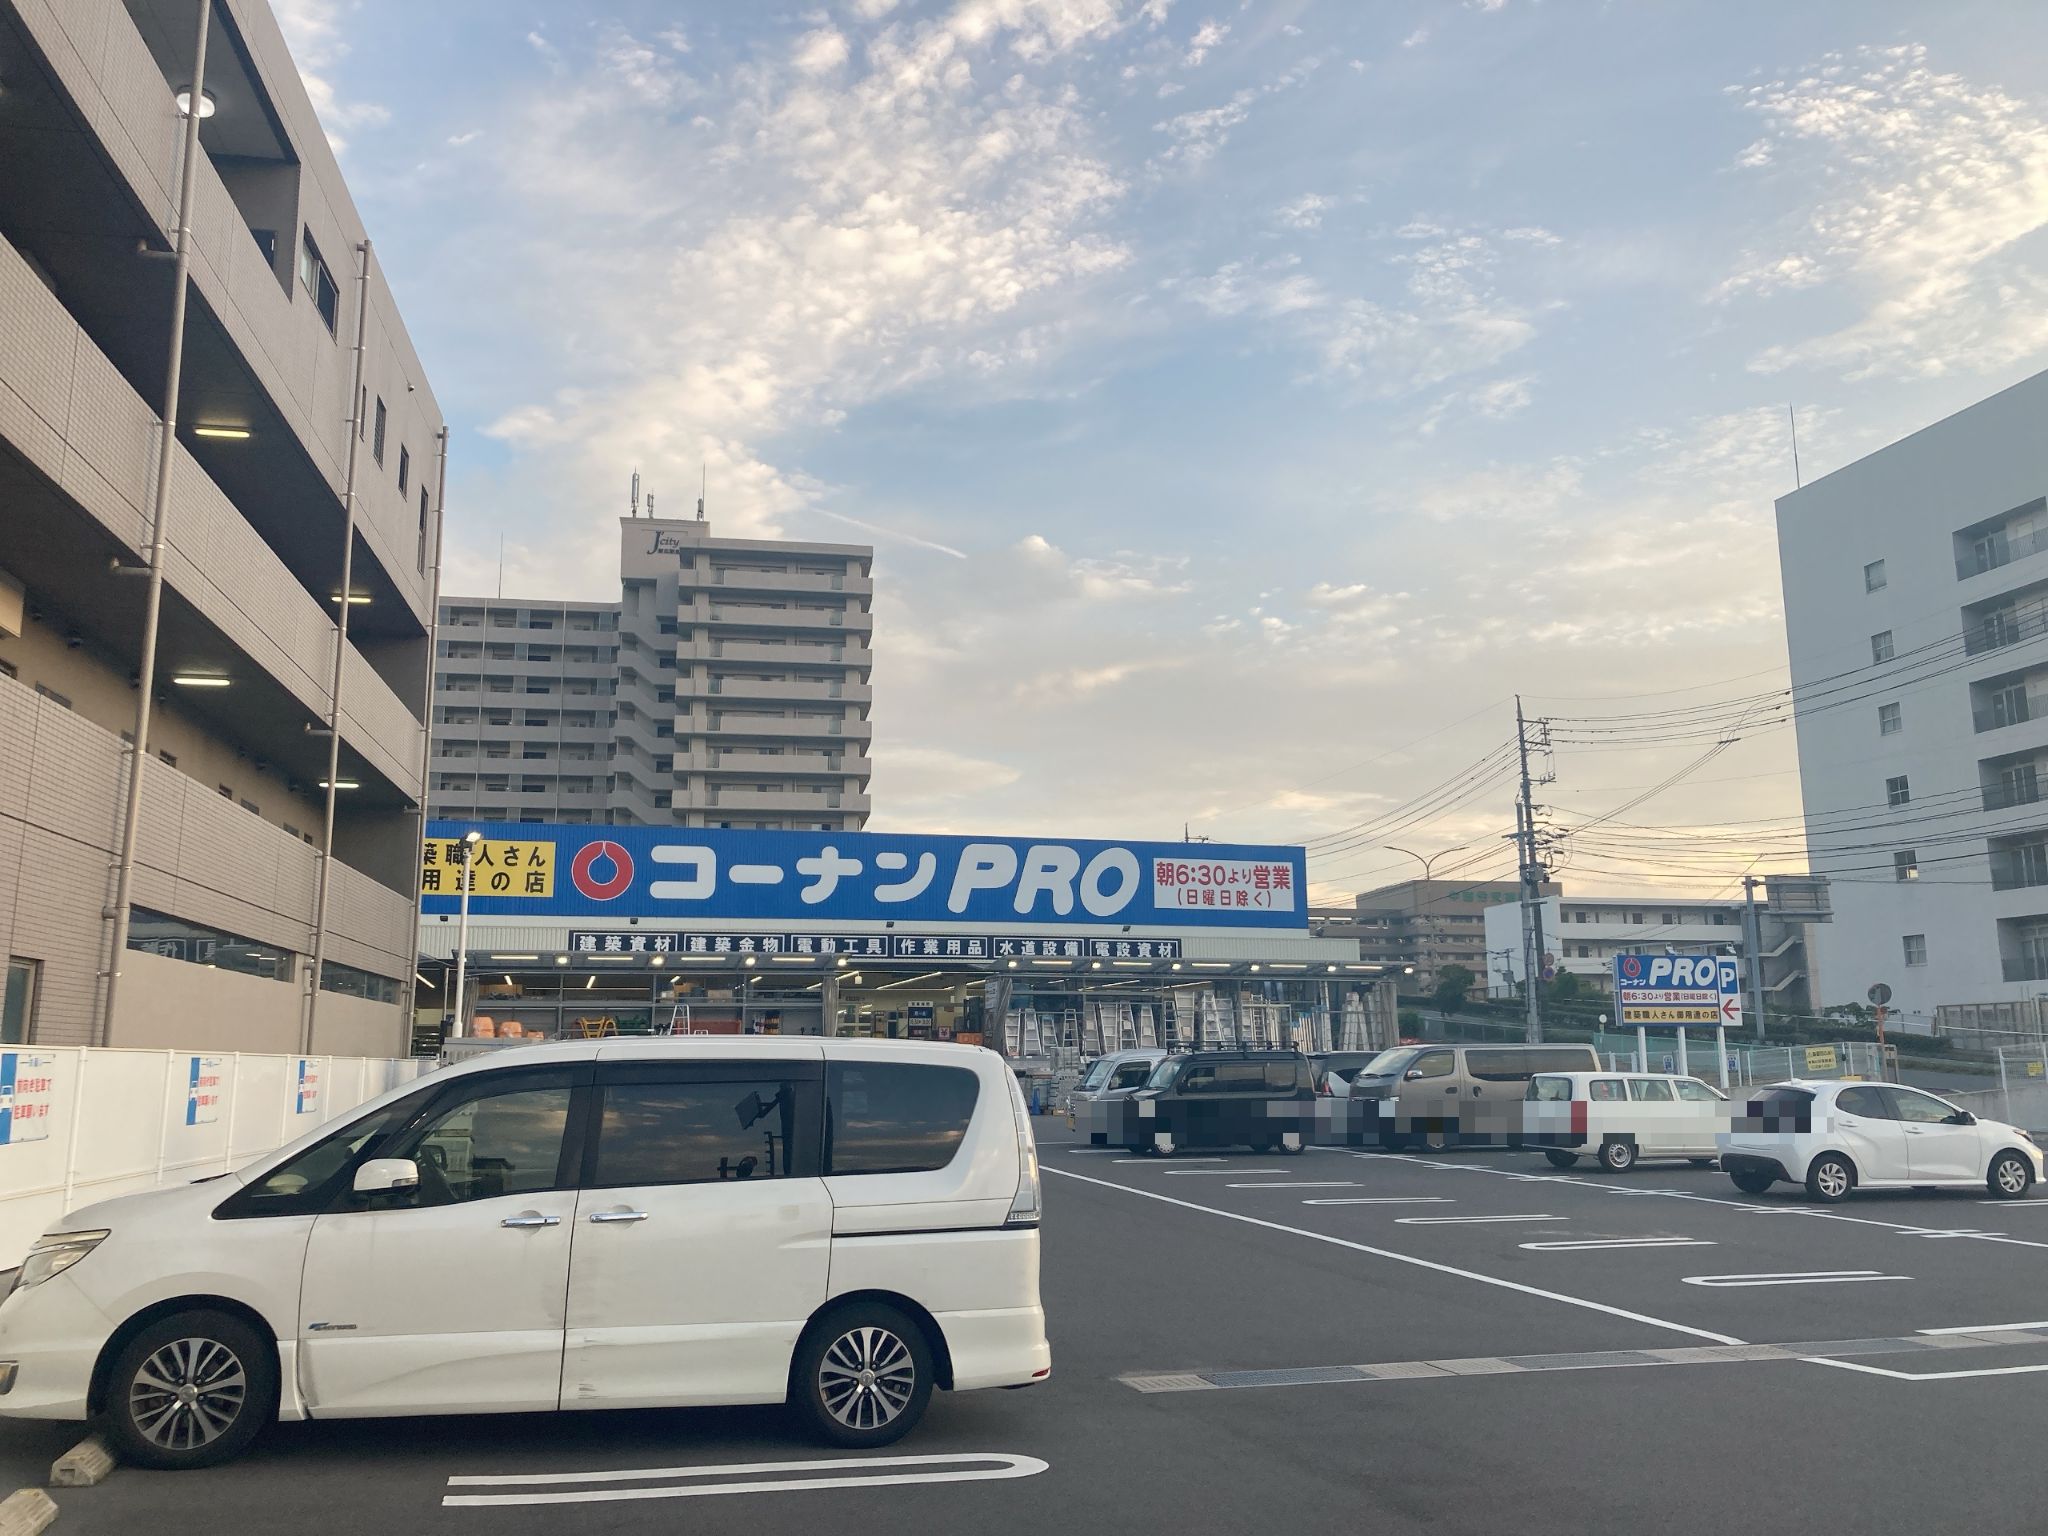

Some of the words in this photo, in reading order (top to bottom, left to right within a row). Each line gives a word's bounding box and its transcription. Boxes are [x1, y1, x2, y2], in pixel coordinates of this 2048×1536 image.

[1156, 861, 1291, 890] 朝6:30より営業
[1177, 887, 1271, 908] (日曜日除く)
[579, 935, 672, 952] 建築資材
[690, 937, 779, 953] 建築金物
[797, 938, 882, 954] 電動工具
[900, 938, 982, 955] 作業用品
[1000, 940, 1079, 956] 水道設備
[1095, 942, 1173, 958] 電設資材
[1649, 957, 1717, 987] PRO
[1720, 967, 1735, 988] P
[1620, 978, 1647, 986] コーナン
